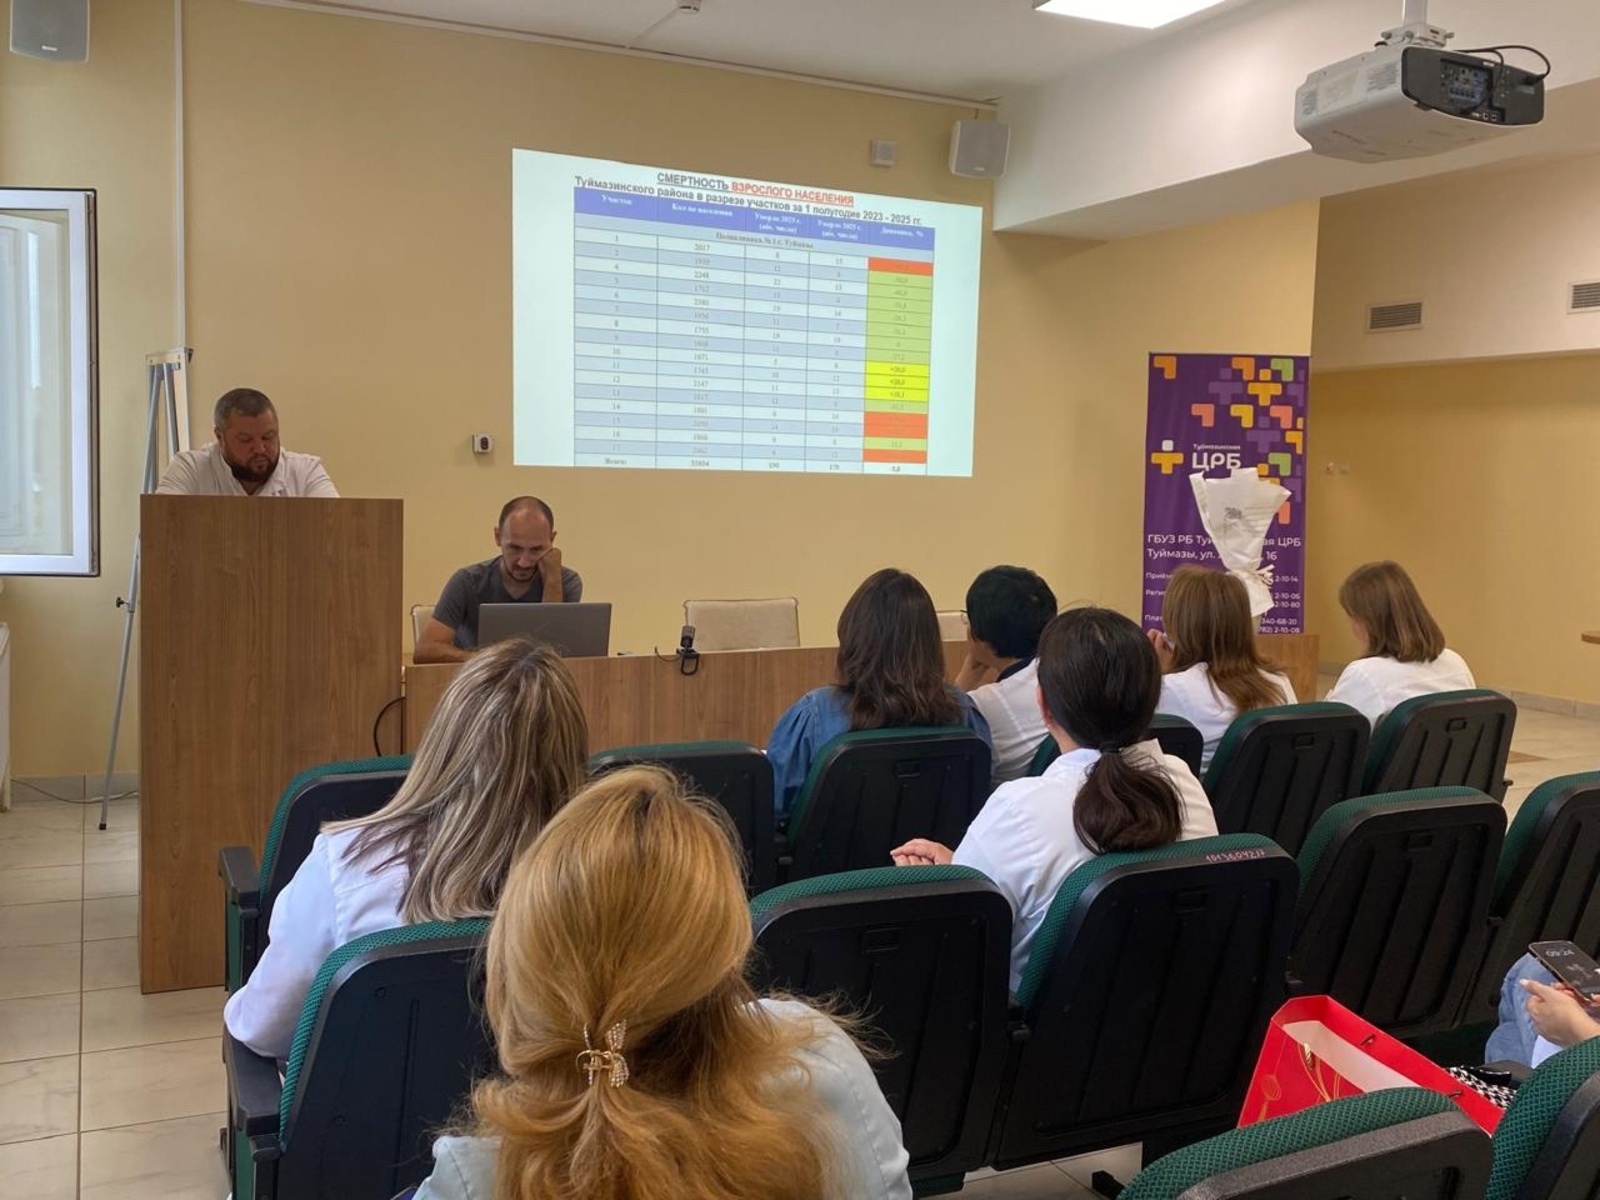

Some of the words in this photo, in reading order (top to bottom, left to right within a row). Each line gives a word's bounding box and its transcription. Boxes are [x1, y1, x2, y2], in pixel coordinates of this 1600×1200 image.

[657, 172, 729, 190] СМЕРТНОСТЬ
[731, 182, 791, 197] ВЗРОСЛОГО
[795, 190, 854, 205] НАСЕЛЕНИЯ
[575, 175, 655, 195] Туймазинского
[657, 187, 694, 201] района
[697, 192, 703, 200] в
[705, 193, 745, 206] разрезе
[747, 199, 791, 211] участков
[792, 203, 802, 212] за
[805, 204, 810, 213] 1
[813, 206, 861, 220] полугодие
[863, 209, 883, 221] 2023
[891, 213, 911, 224] 2025
[1191, 452, 1242, 471] ЦРБ
[1147, 534, 1176, 545] ГБУЗ
[1178, 535, 1194, 545] РБ
[1278, 538, 1301, 549] ЦРБ
[1147, 548, 1198, 560] Туймазы,
[1200, 551, 1215, 561] ул.
[1266, 551, 1278, 561] 16
